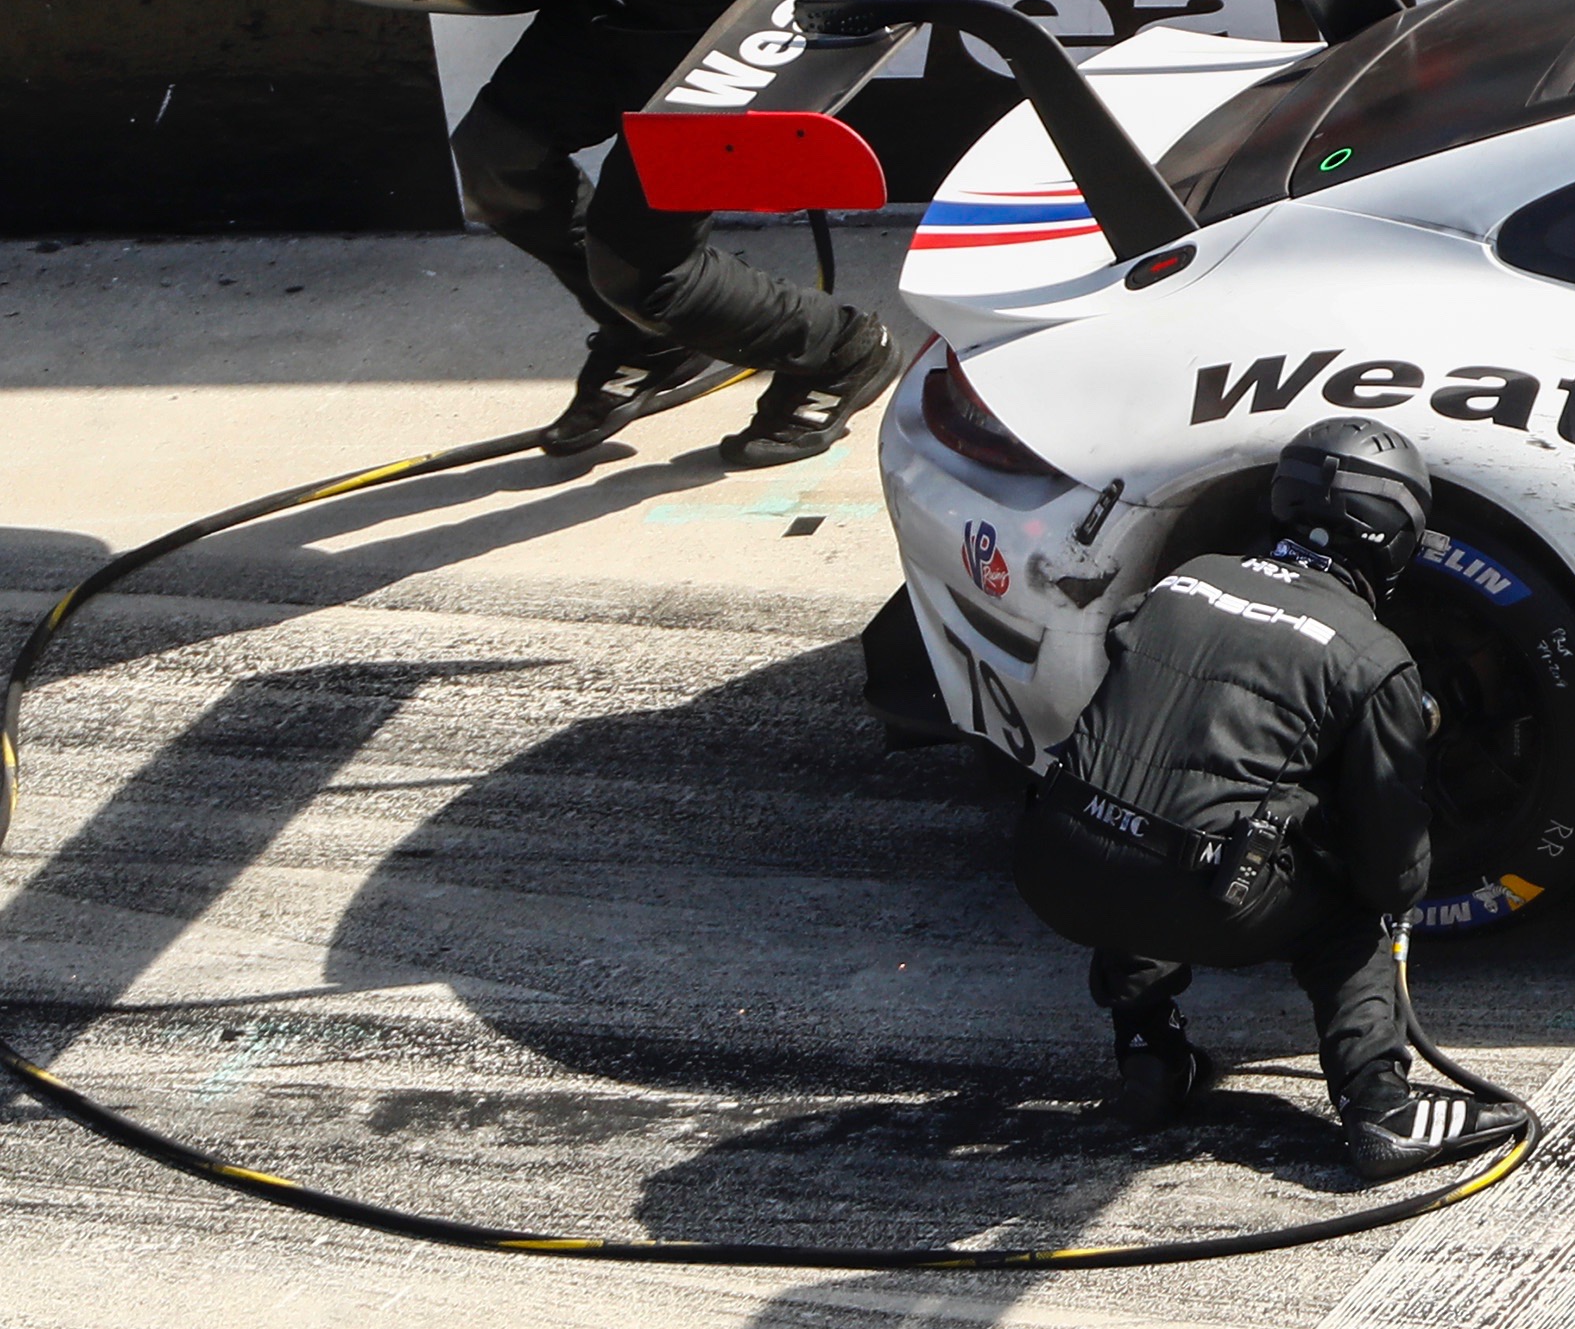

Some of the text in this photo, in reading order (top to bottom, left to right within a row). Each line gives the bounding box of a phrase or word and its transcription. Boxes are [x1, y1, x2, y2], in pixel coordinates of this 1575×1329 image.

[963, 519, 998, 590] VP
[1241, 557, 1300, 584] HRX
[1151, 575, 1337, 646] PORSCHE
[942, 624, 1037, 767] 79
[1083, 793, 1151, 838] MRTC
[1537, 818, 1574, 858] RR
